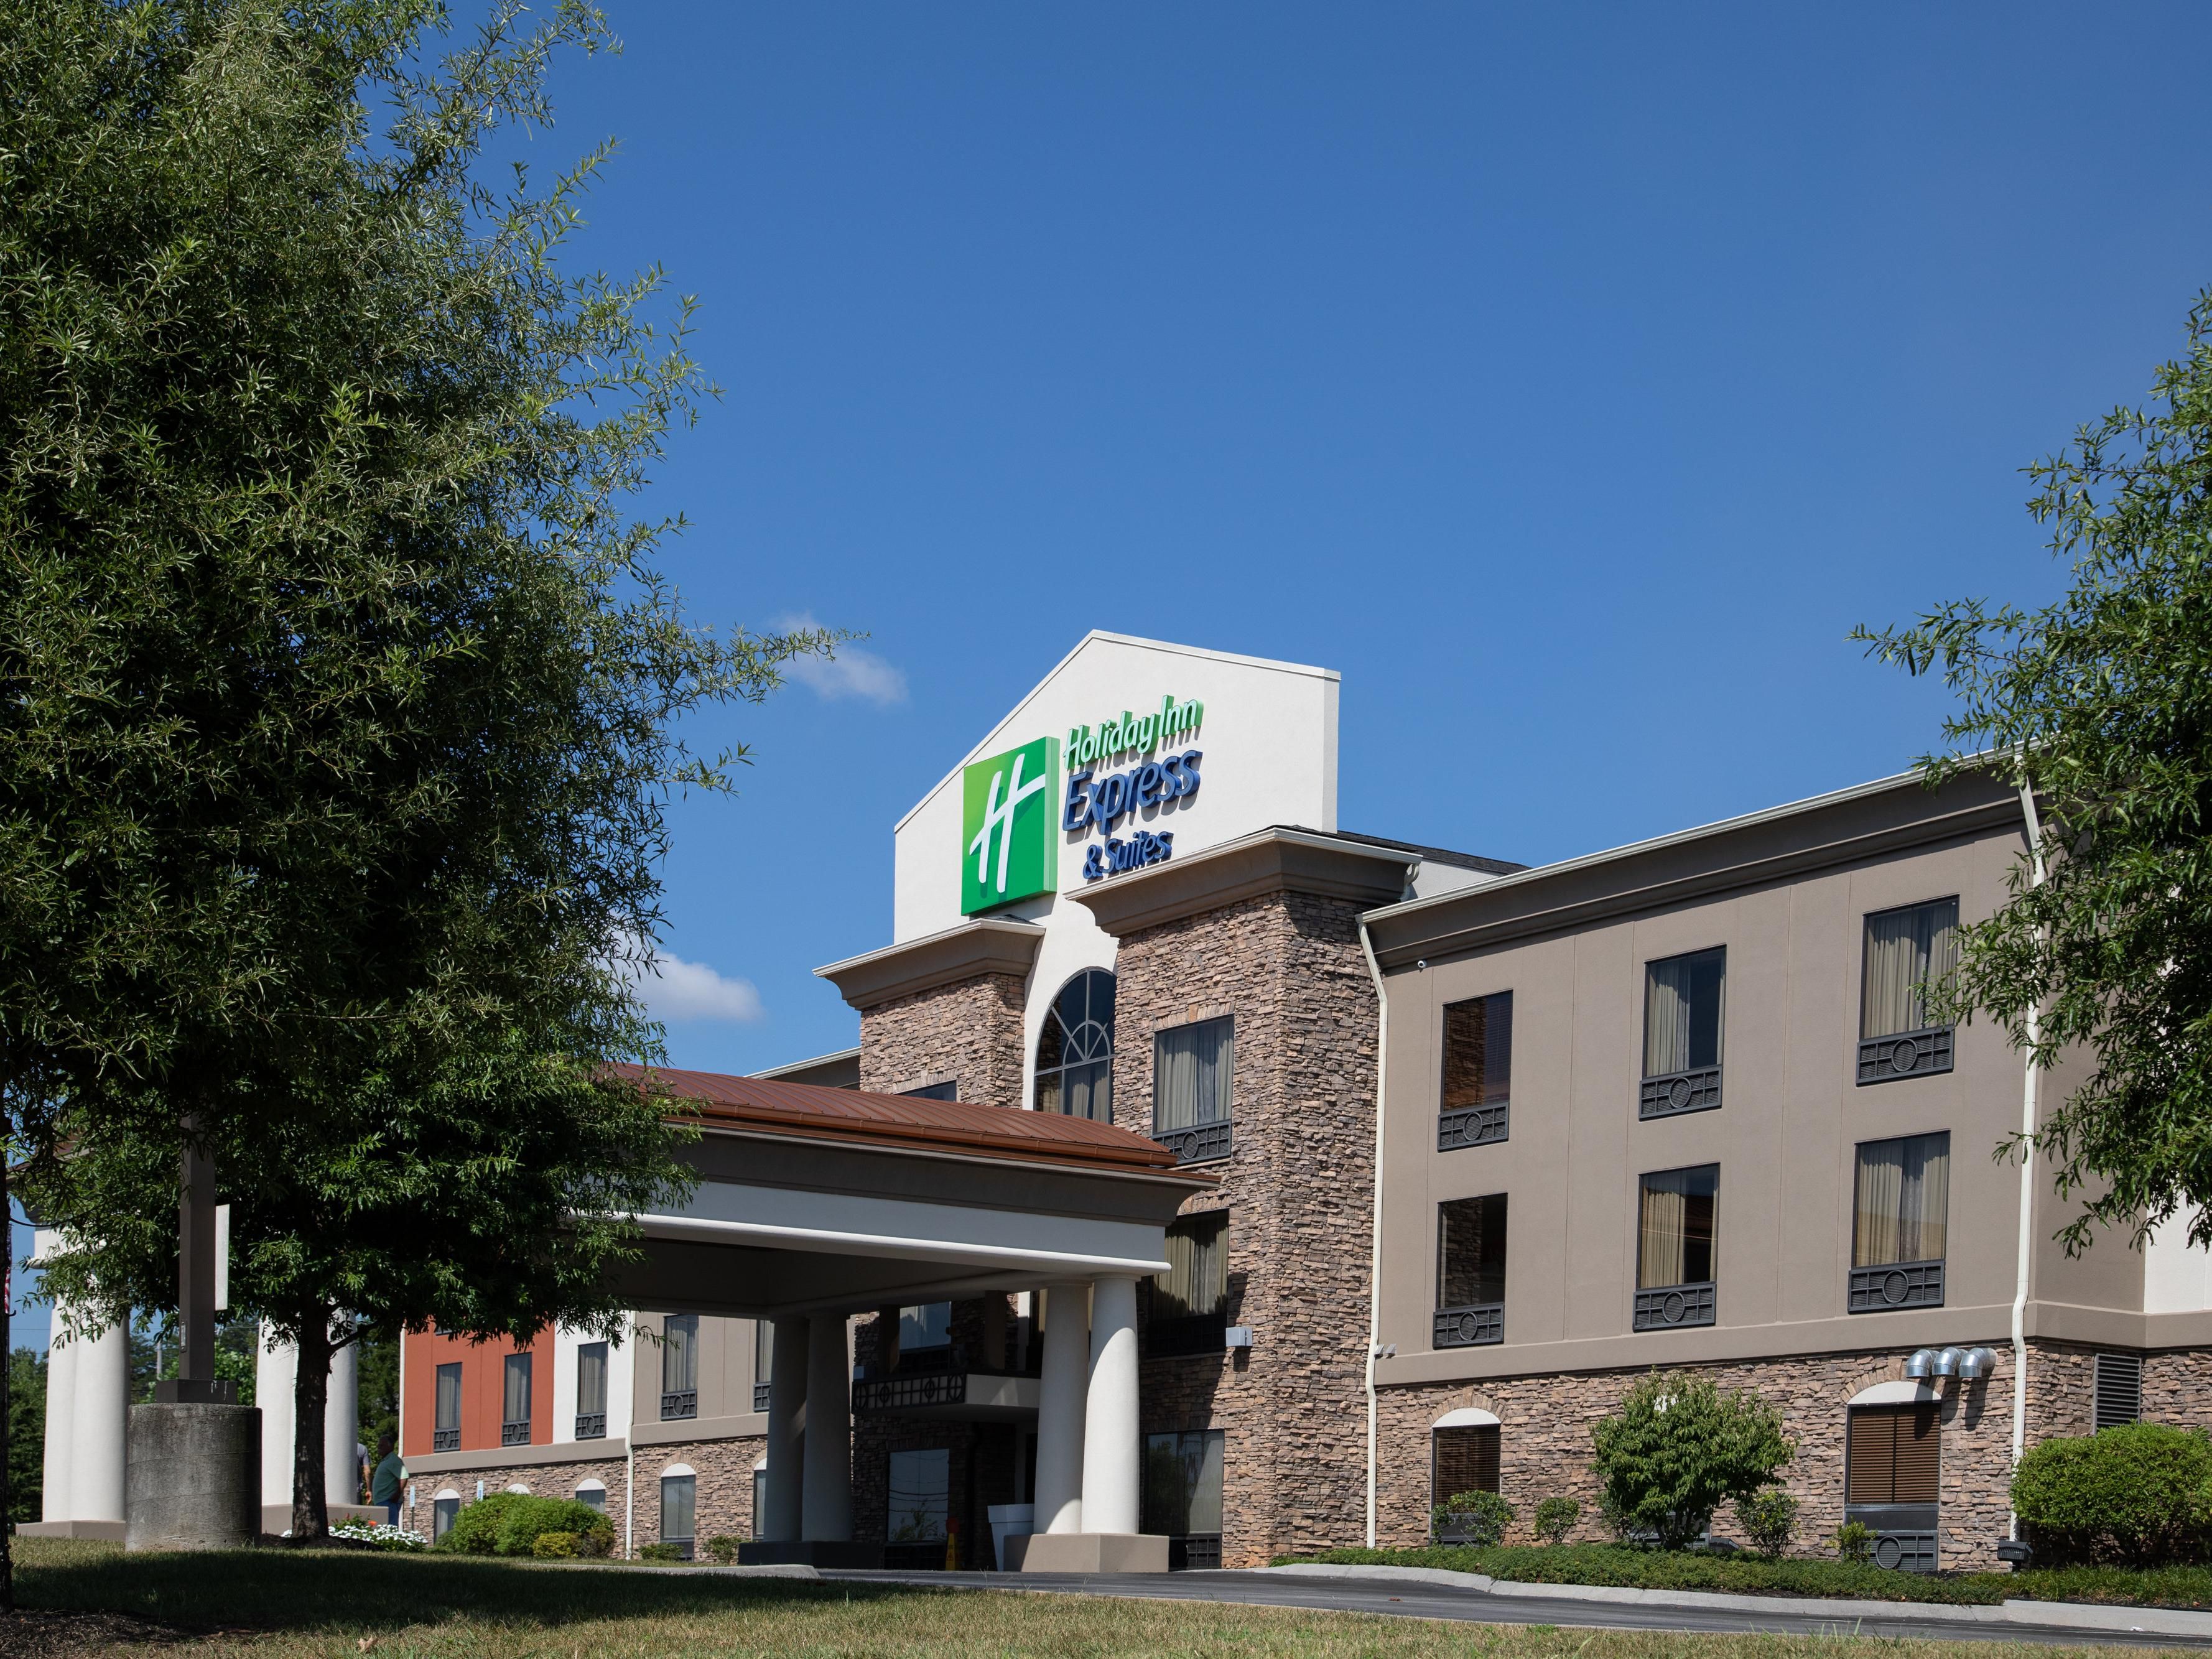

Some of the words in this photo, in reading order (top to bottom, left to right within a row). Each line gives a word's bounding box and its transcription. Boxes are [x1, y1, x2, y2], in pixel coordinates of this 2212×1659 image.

[1062, 710, 1159, 769] Holiday
[1158, 694, 1204, 738] Inn
[969, 753, 1046, 893] H
[1062, 750, 1203, 835] Express
[1083, 844, 1104, 880] &
[1102, 830, 1174, 874] Suites
